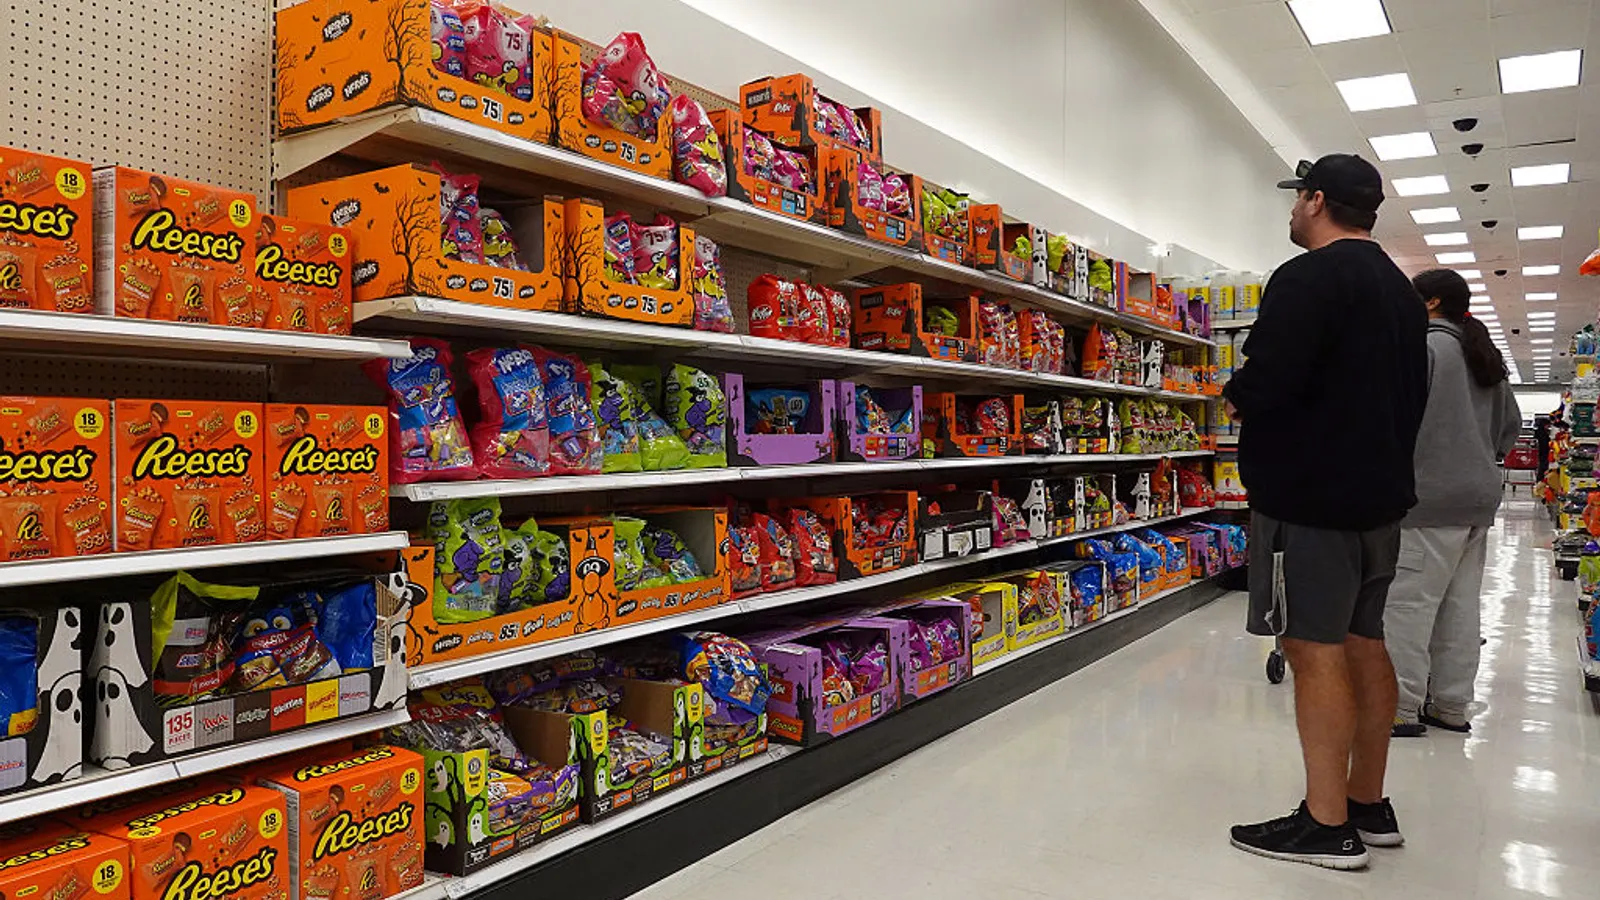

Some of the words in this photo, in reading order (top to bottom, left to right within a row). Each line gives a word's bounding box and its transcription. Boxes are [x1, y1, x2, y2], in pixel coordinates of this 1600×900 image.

[505, 32, 520, 50] 75
[482, 98, 498, 119] 75
[620, 142, 632, 161] 75
[63, 172, 78, 186] 18
[234, 203, 245, 216] 18
[0, 202, 77, 238] ese's
[132, 209, 243, 262] Reese's
[645, 230, 663, 245] 75
[255, 244, 342, 287] Reese's
[493, 277, 509, 297] 75
[641, 296, 653, 313] 75
[81, 413, 96, 425] 18
[240, 415, 251, 426] 18
[368, 417, 379, 428] 18
[134, 435, 250, 478] Reese's
[281, 436, 379, 473] Reese's
[0, 449, 95, 480] eese's
[166, 712, 192, 734] 135
[404, 772, 415, 784] 18
[264, 813, 277, 826] 18
[314, 803, 414, 860] Reese's
[100, 865, 115, 880] 18
[162, 848, 276, 900] Reese's
